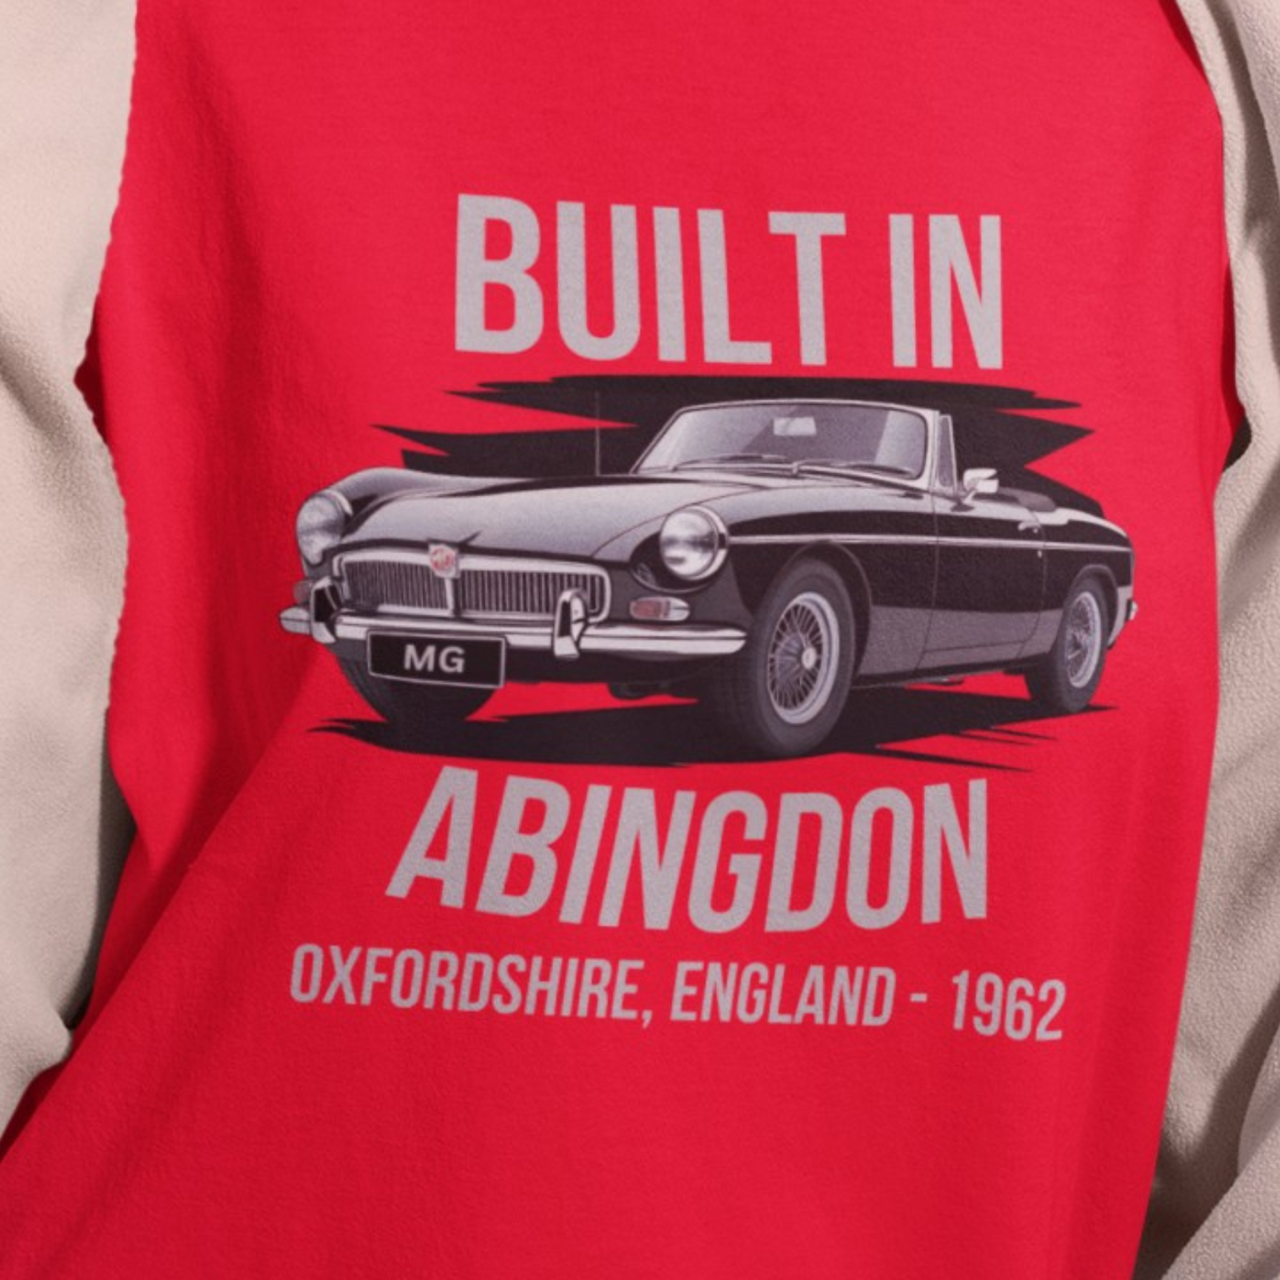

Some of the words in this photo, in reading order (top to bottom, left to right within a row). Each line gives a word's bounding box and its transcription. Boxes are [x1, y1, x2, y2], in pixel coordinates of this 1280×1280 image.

[454, 193, 847, 366] BUILT
[888, 213, 1003, 370] IN
[403, 643, 466, 674] MG
[385, 765, 988, 933] ABINGDON
[290, 943, 653, 1030] OXFORDSHIRE,
[670, 961, 897, 1027] ENGLAND
[950, 969, 1067, 1042] 1962
